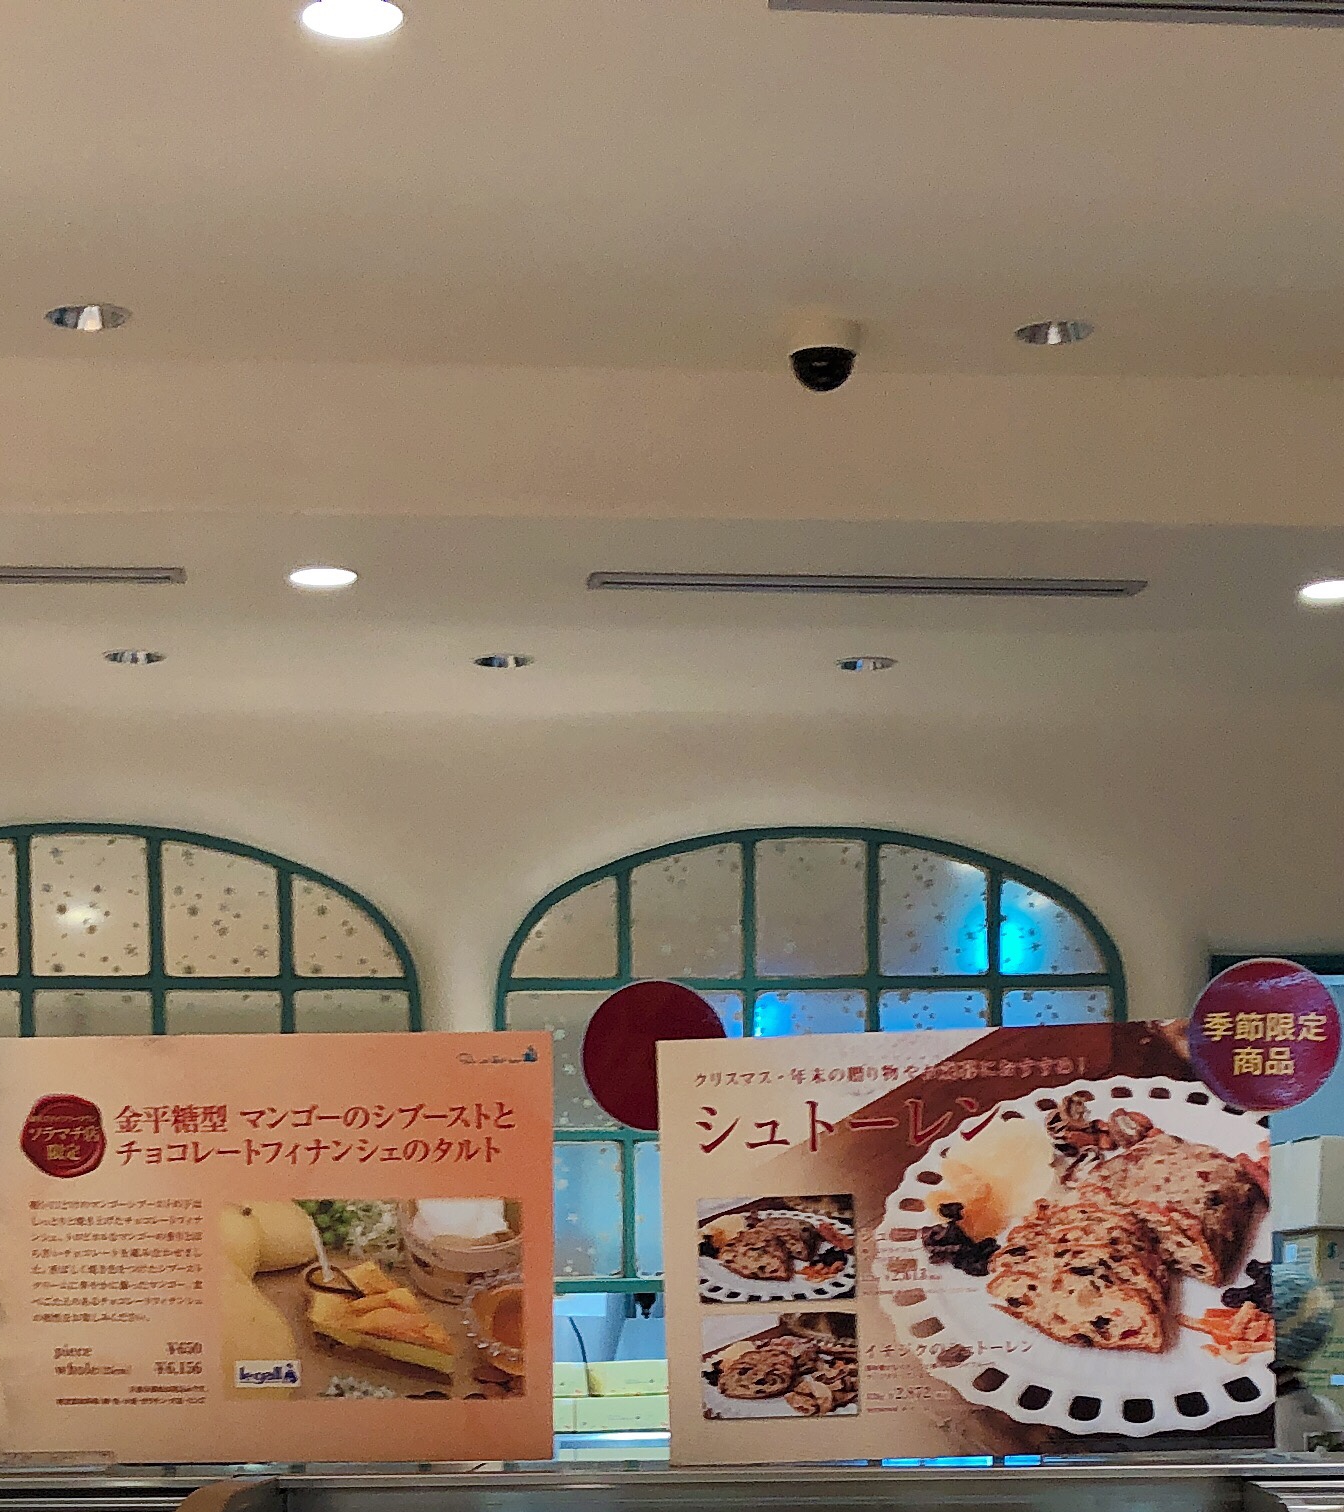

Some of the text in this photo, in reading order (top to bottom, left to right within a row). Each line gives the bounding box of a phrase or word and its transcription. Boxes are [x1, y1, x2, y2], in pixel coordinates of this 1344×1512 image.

[1202, 1012, 1327, 1041] 季節限定
[1232, 1046, 1295, 1075] 商品
[115, 1102, 517, 1134] 金平糖型 マンゴーのシブーストと
[695, 1097, 1001, 1154] シュトーレン
[115, 1137, 502, 1166] チョコレートフィナンシェのタルト
